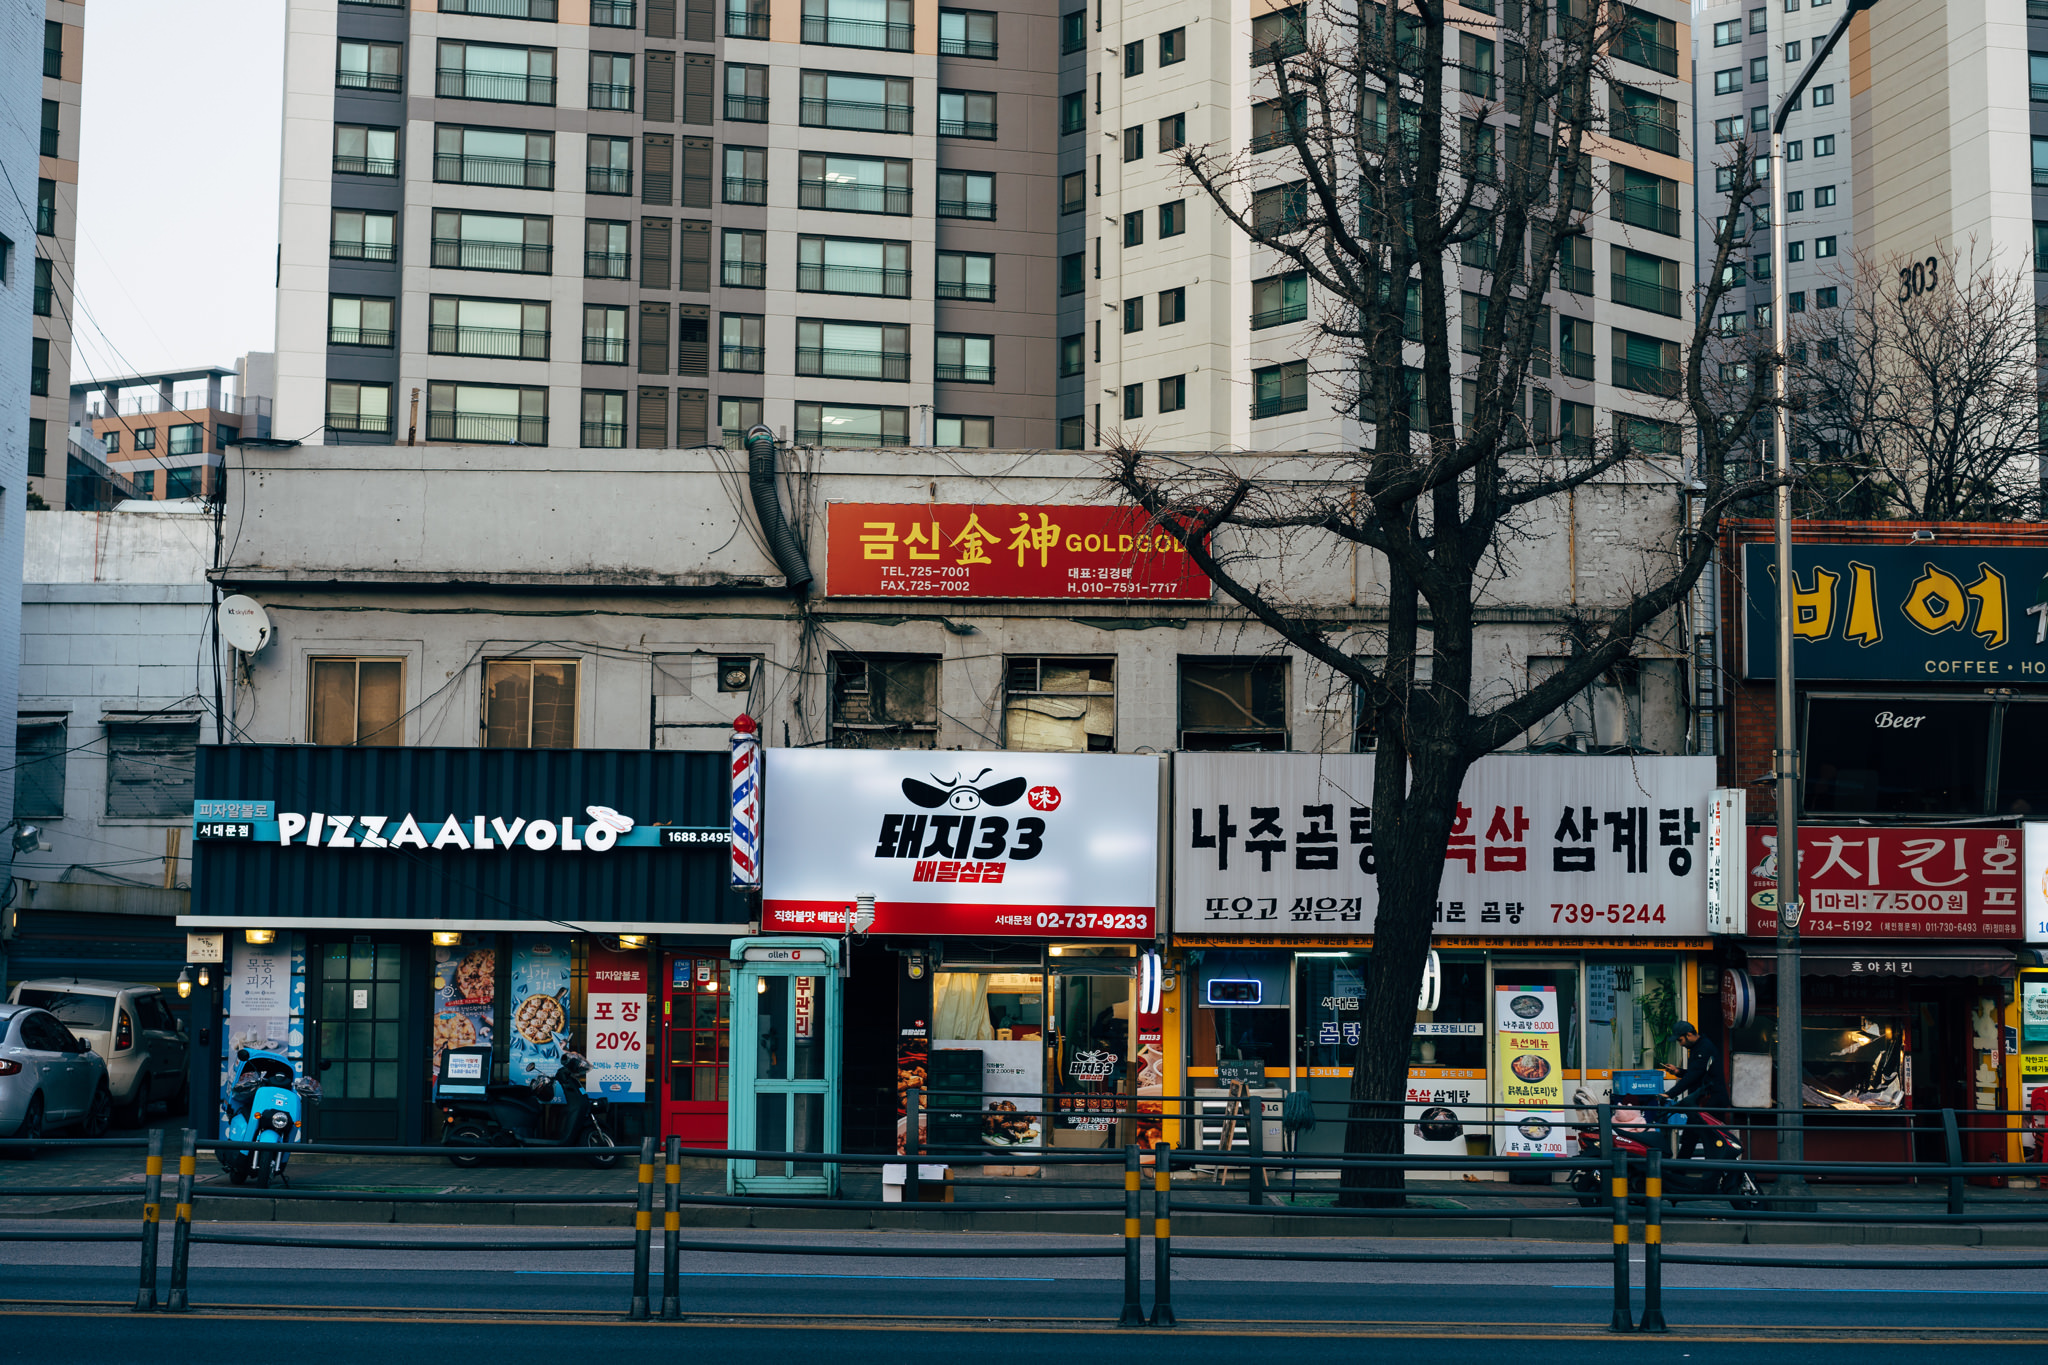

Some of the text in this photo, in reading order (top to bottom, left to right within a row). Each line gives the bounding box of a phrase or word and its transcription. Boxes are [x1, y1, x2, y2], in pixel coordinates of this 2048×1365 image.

[1900, 256, 1938, 302] 303
[859, 522, 940, 560] 금신
[949, 512, 1061, 567] 金神
[881, 566, 970, 577] TEL.725-7001
[1068, 568, 1132, 579] 대표:김경태
[881, 580, 970, 591] FAX.725-7002
[1925, 660, 1999, 674] COFFEE
[1875, 711, 1926, 729] Beer
[200, 804, 268, 818] 피자알볼로
[200, 824, 249, 837] 서대문점
[668, 832, 732, 842] 1688.8495
[875, 814, 1045, 860] 돼지33
[1553, 805, 1700, 876] 삼계탕
[1810, 834, 1969, 886] 치킨
[913, 860, 1006, 884] 배달삼겹
[1982, 837, 2016, 914] 호프
[1204, 896, 1362, 921] 또오고 싶은집
[1815, 893, 1963, 911] 1마리: 7.500원
[775, 911, 816, 922] 직화불맛
[1481, 902, 1525, 924] 곰탕
[1550, 903, 1666, 924] 739-5244
[995, 913, 1148, 929] 서대문점 02-737-9233
[1809, 920, 1872, 931] 734-5192
[1926, 923, 1977, 933] 011-730-6493
[768, 951, 788, 959] olleh
[246, 958, 275, 974] 목동
[1851, 962, 1912, 973] 호야치킨
[246, 974, 275, 989] 피자
[595, 971, 640, 981] 피자알볼로
[1211, 982, 1258, 1000] OPEN
[594, 1002, 640, 1022] 포장
[1431, 1025, 1477, 1033] 포장됩니다
[1503, 1021, 1554, 1030] 나주곰탕 8,000
[596, 1031, 641, 1051] 20%
[1319, 1022, 1360, 1046] 곰탕
[1510, 1038, 1549, 1048] 특선메뉴
[1407, 1088, 1470, 1103] 흑삼 삼계탕
[1543, 1143, 1562, 1152] 7,000
